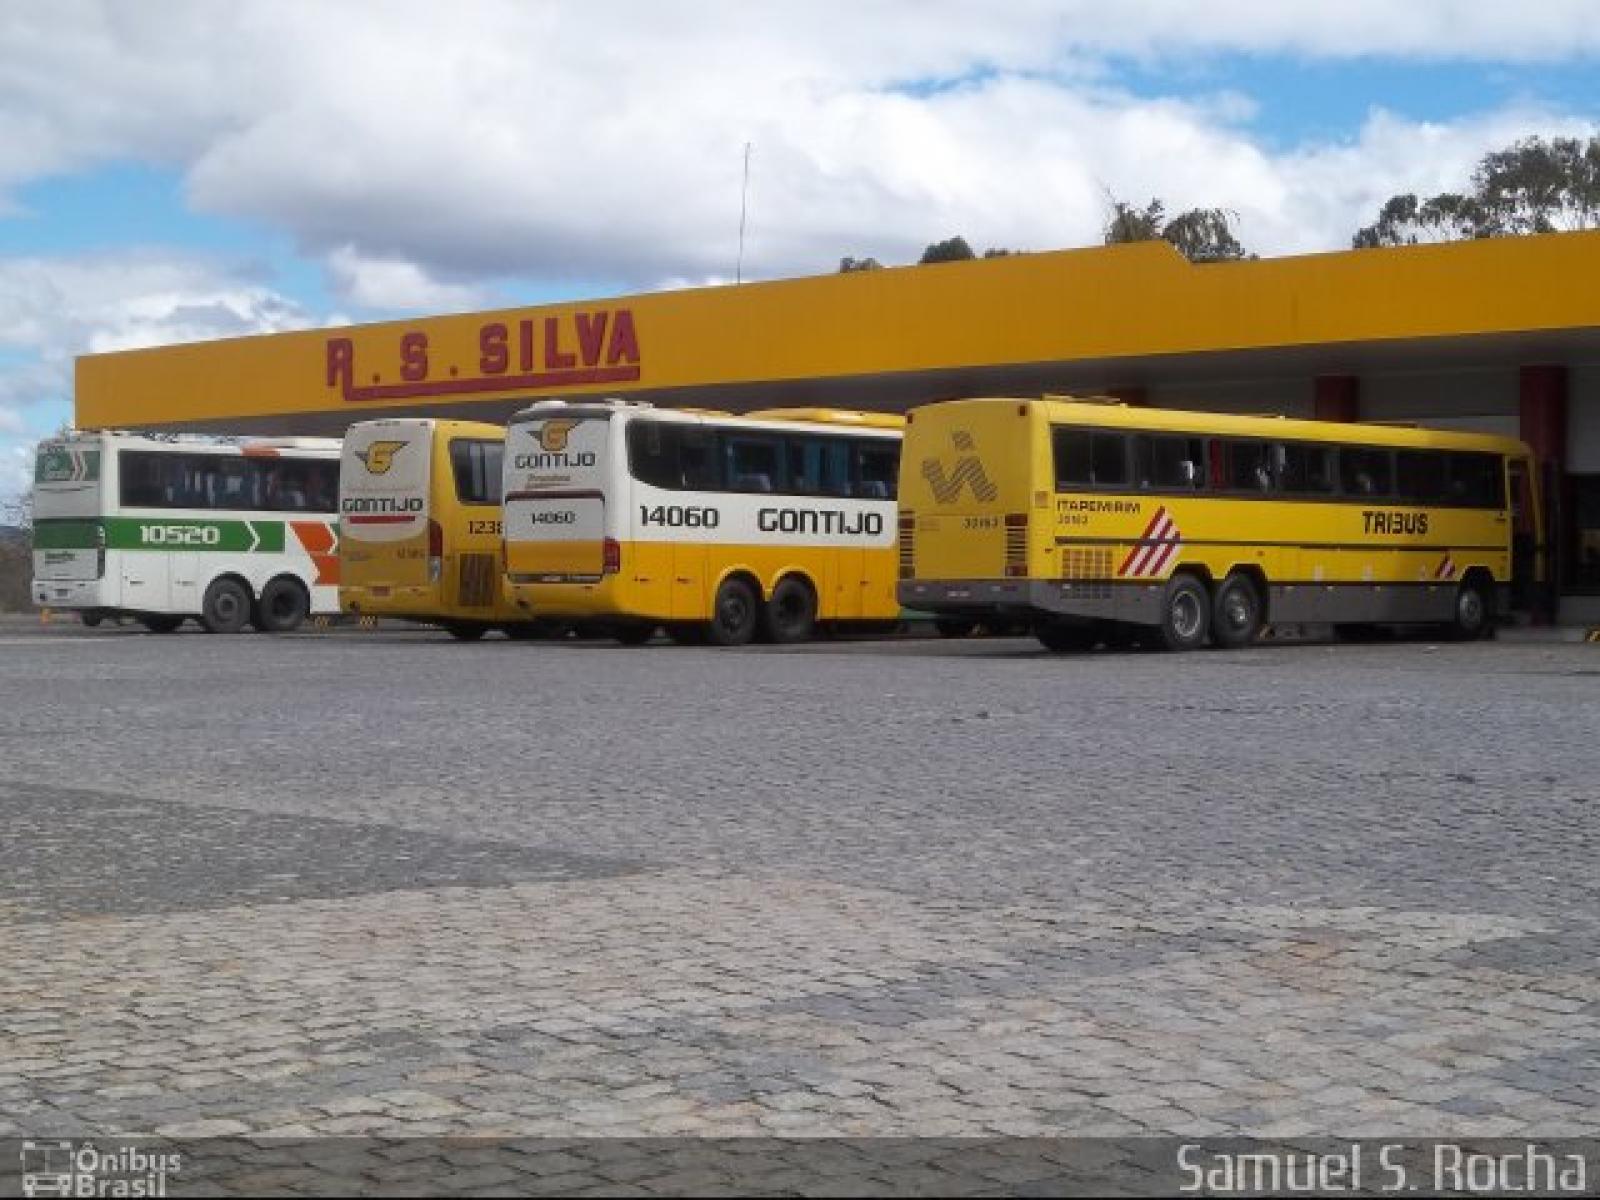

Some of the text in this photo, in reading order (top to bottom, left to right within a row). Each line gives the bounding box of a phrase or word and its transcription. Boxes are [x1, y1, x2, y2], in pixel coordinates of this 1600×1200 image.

[479, 310, 640, 375] SILVA
[514, 451, 596, 469] GONTIJO
[342, 497, 423, 512] GONTIJO
[1056, 500, 1141, 514] ITAPEMIRIM
[532, 511, 575, 524] 14060
[640, 505, 719, 527] 14060
[757, 508, 883, 535] GONTIJO
[1362, 510, 1428, 535] TRIBUS
[139, 525, 220, 545] 10520
